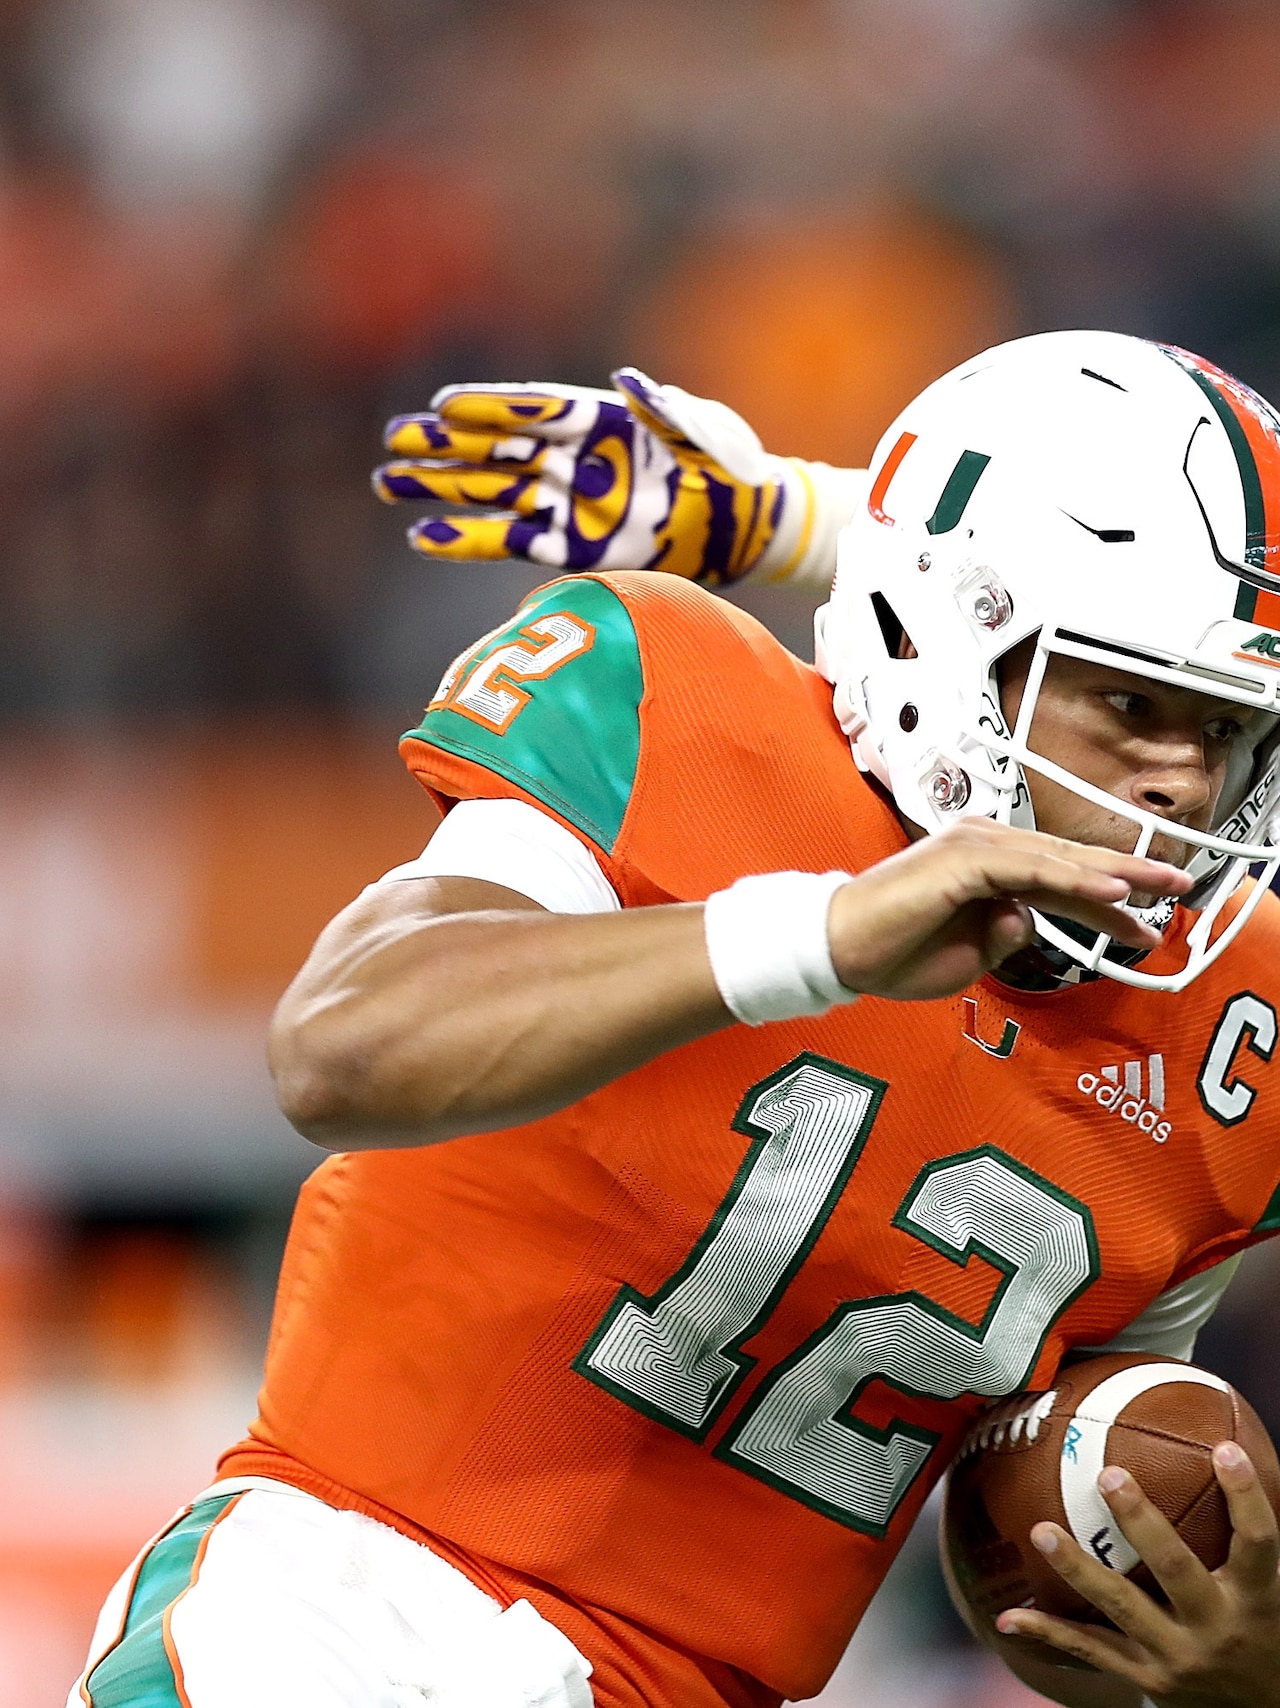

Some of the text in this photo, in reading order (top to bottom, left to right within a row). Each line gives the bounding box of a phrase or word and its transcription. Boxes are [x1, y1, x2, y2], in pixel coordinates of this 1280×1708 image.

[961, 996, 1022, 1060] U
[1196, 990, 1280, 1129] C
[1076, 1070, 1174, 1145] adidas
[569, 1050, 1101, 1539] 12
